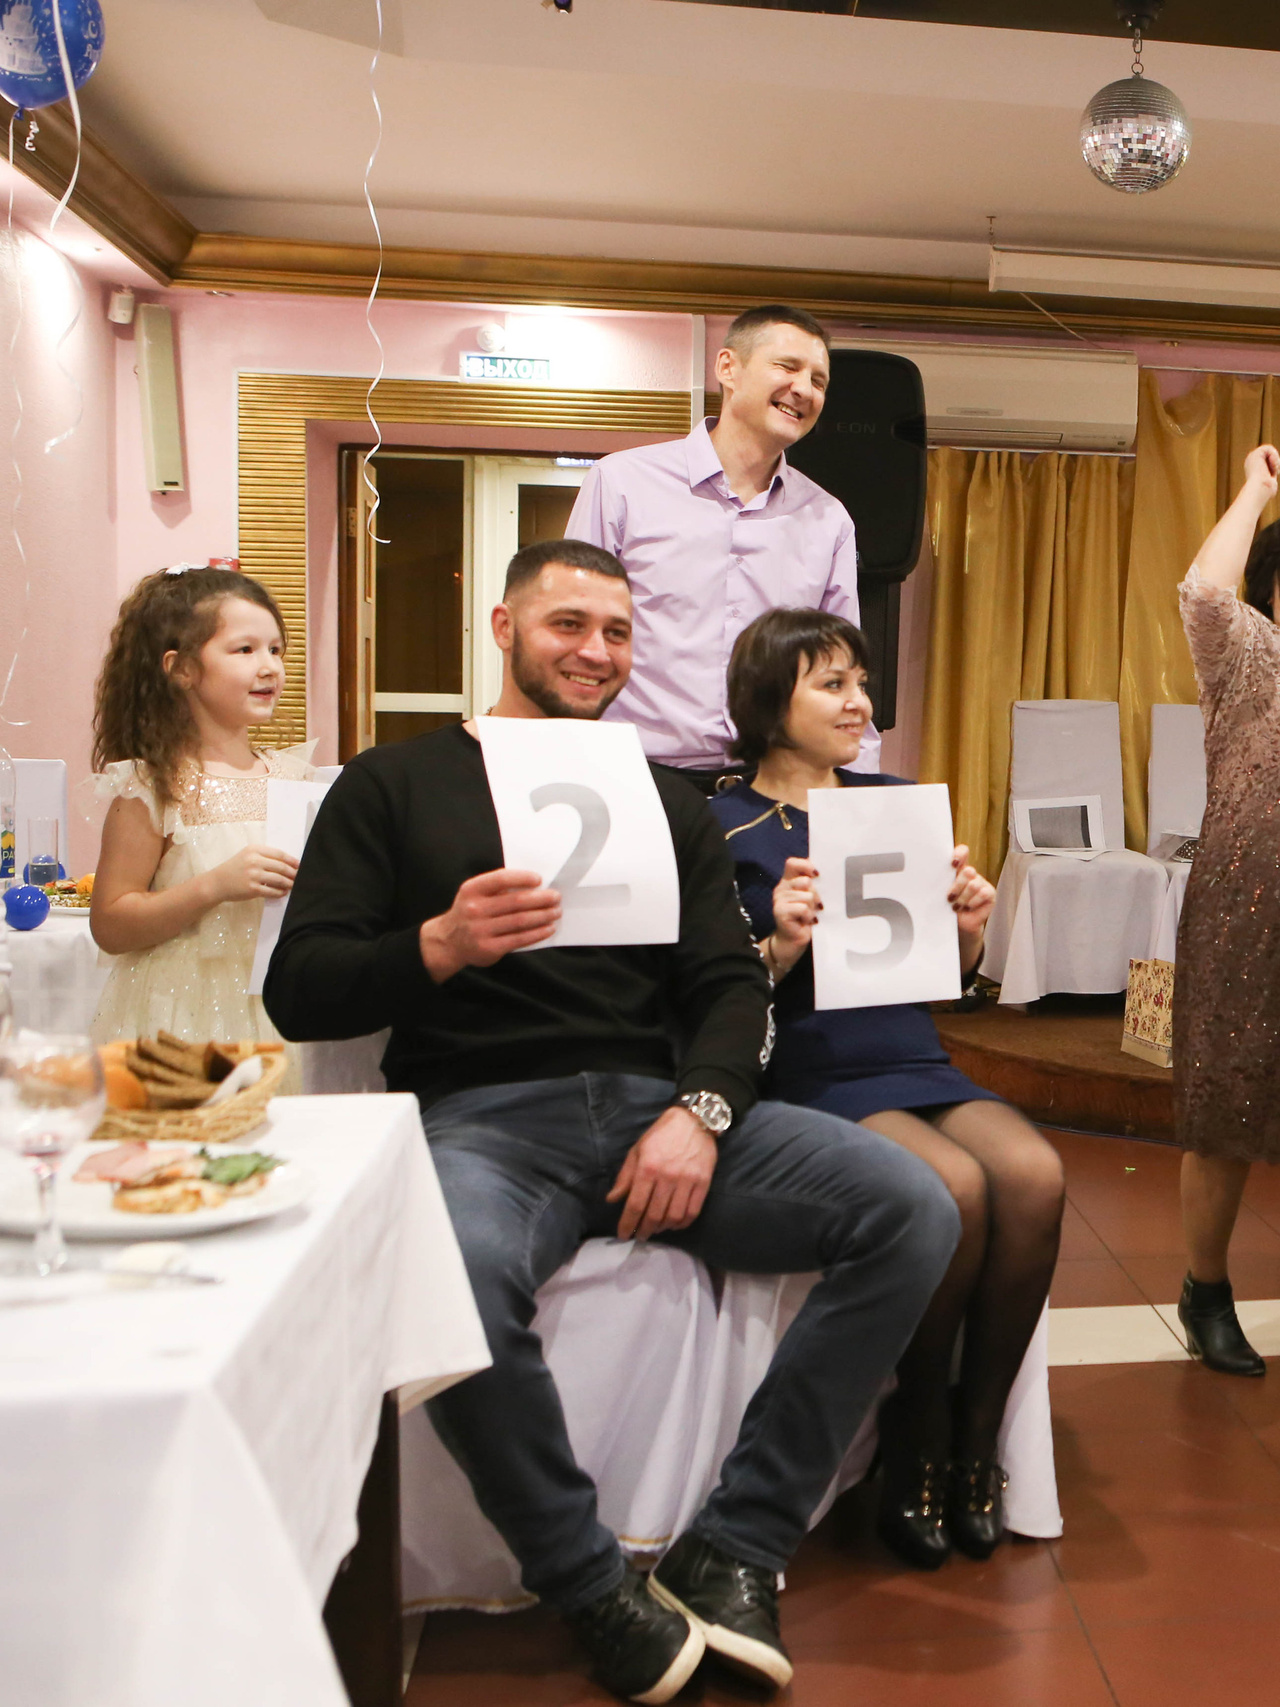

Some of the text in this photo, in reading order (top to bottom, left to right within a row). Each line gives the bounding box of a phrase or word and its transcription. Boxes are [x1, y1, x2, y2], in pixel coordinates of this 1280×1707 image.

[467, 356, 549, 379] ВЫХОД
[836, 422, 876, 434] EON
[529, 783, 631, 909] 2
[845, 852, 914, 973] 5
